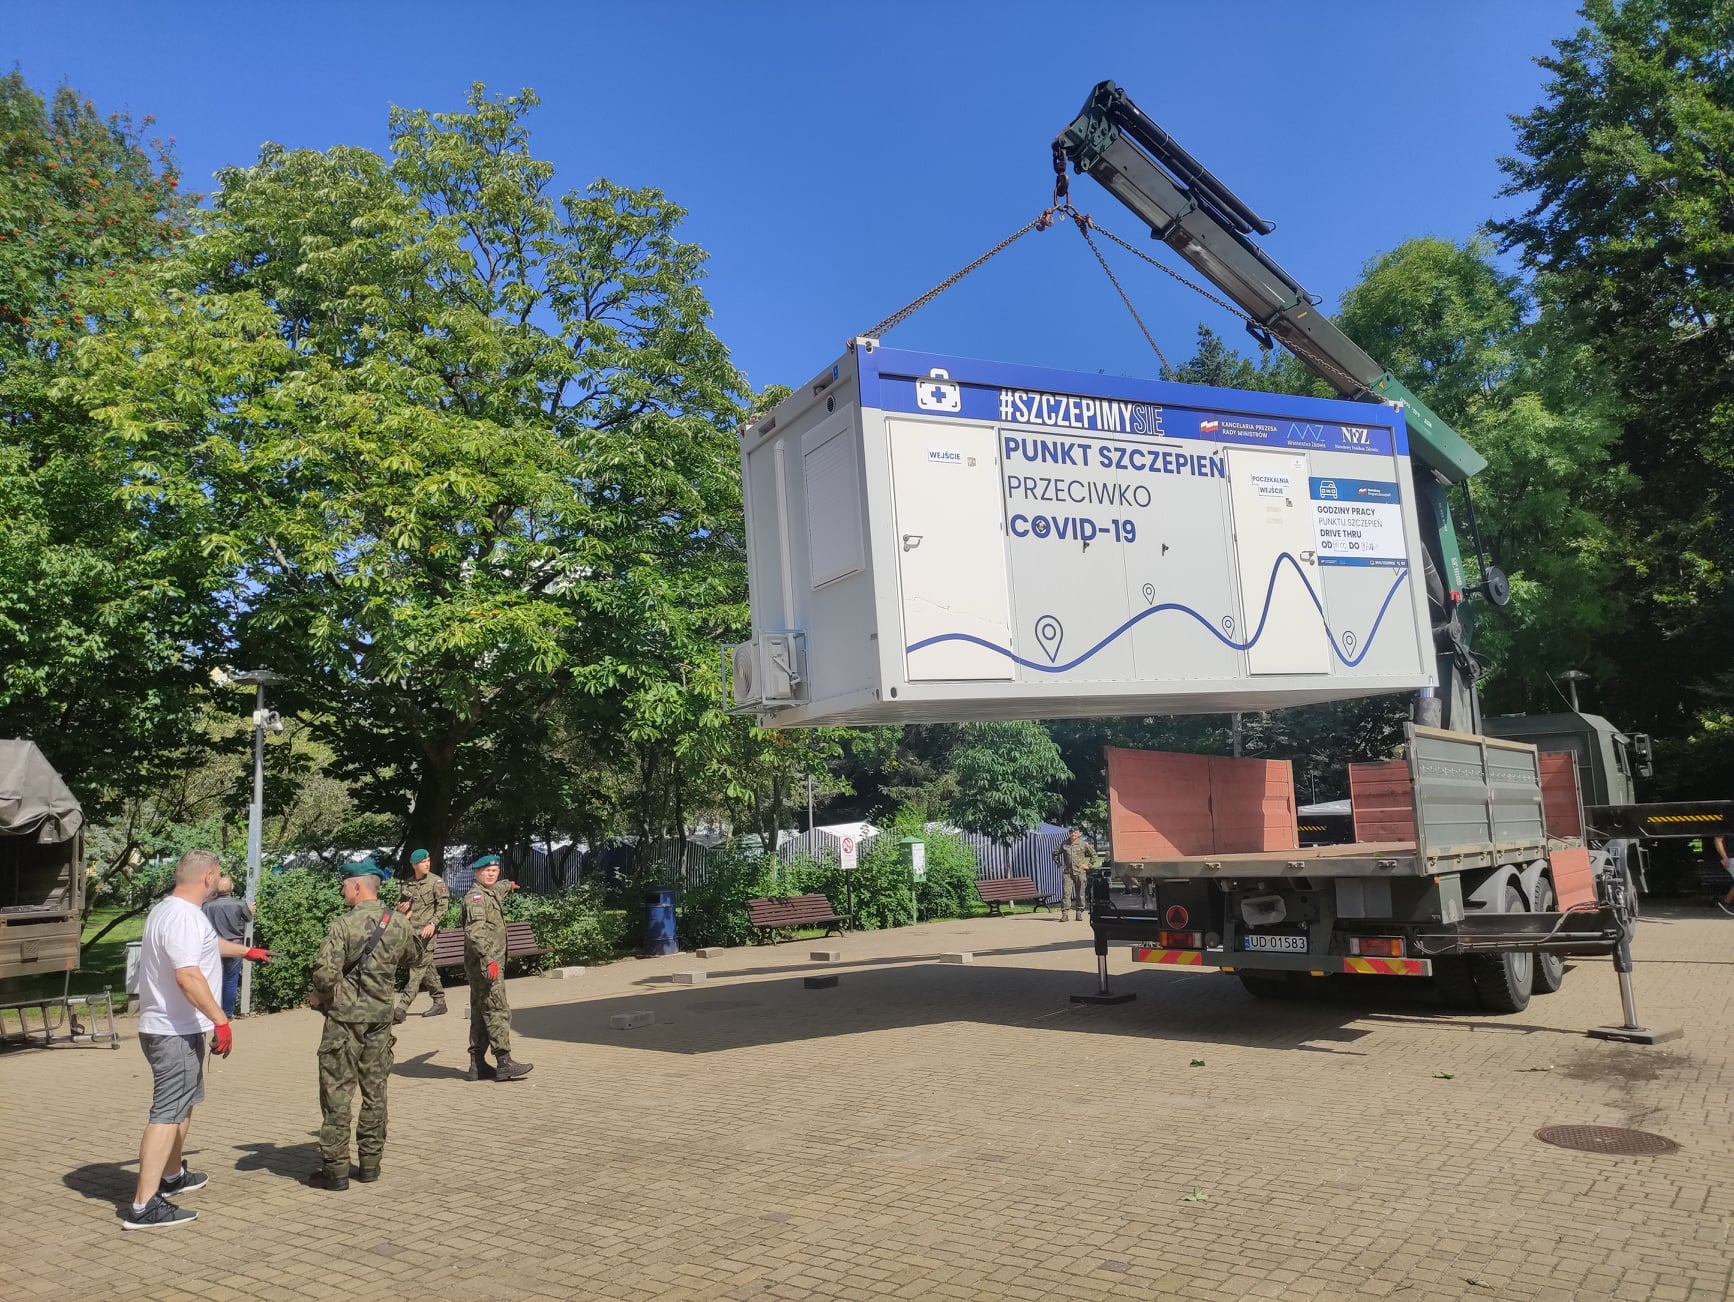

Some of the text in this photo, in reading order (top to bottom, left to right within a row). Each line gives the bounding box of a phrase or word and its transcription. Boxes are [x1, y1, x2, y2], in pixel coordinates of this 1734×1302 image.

[1222, 421, 1254, 430] KANCELARIA
[929, 450, 961, 460] WEJŚCIE
[1005, 437, 1225, 478] PUNKT SZCZEPIEŃ
[1252, 475, 1290, 484] POCZEKALNIA
[1007, 475, 1151, 507] PRZECIWKO
[1259, 485, 1284, 494] WEJŚCIE
[1317, 505, 1376, 516] GODZINY PRACY
[1318, 517, 1383, 528] PUNKTU SZCZEPIEŃ
[1010, 513, 1137, 543] COVID-19
[1320, 529, 1362, 538] DRIVE THRU
[1321, 540, 1333, 549] OD
[1348, 541, 1360, 550] DO
[1250, 935, 1305, 949] UD 01583
